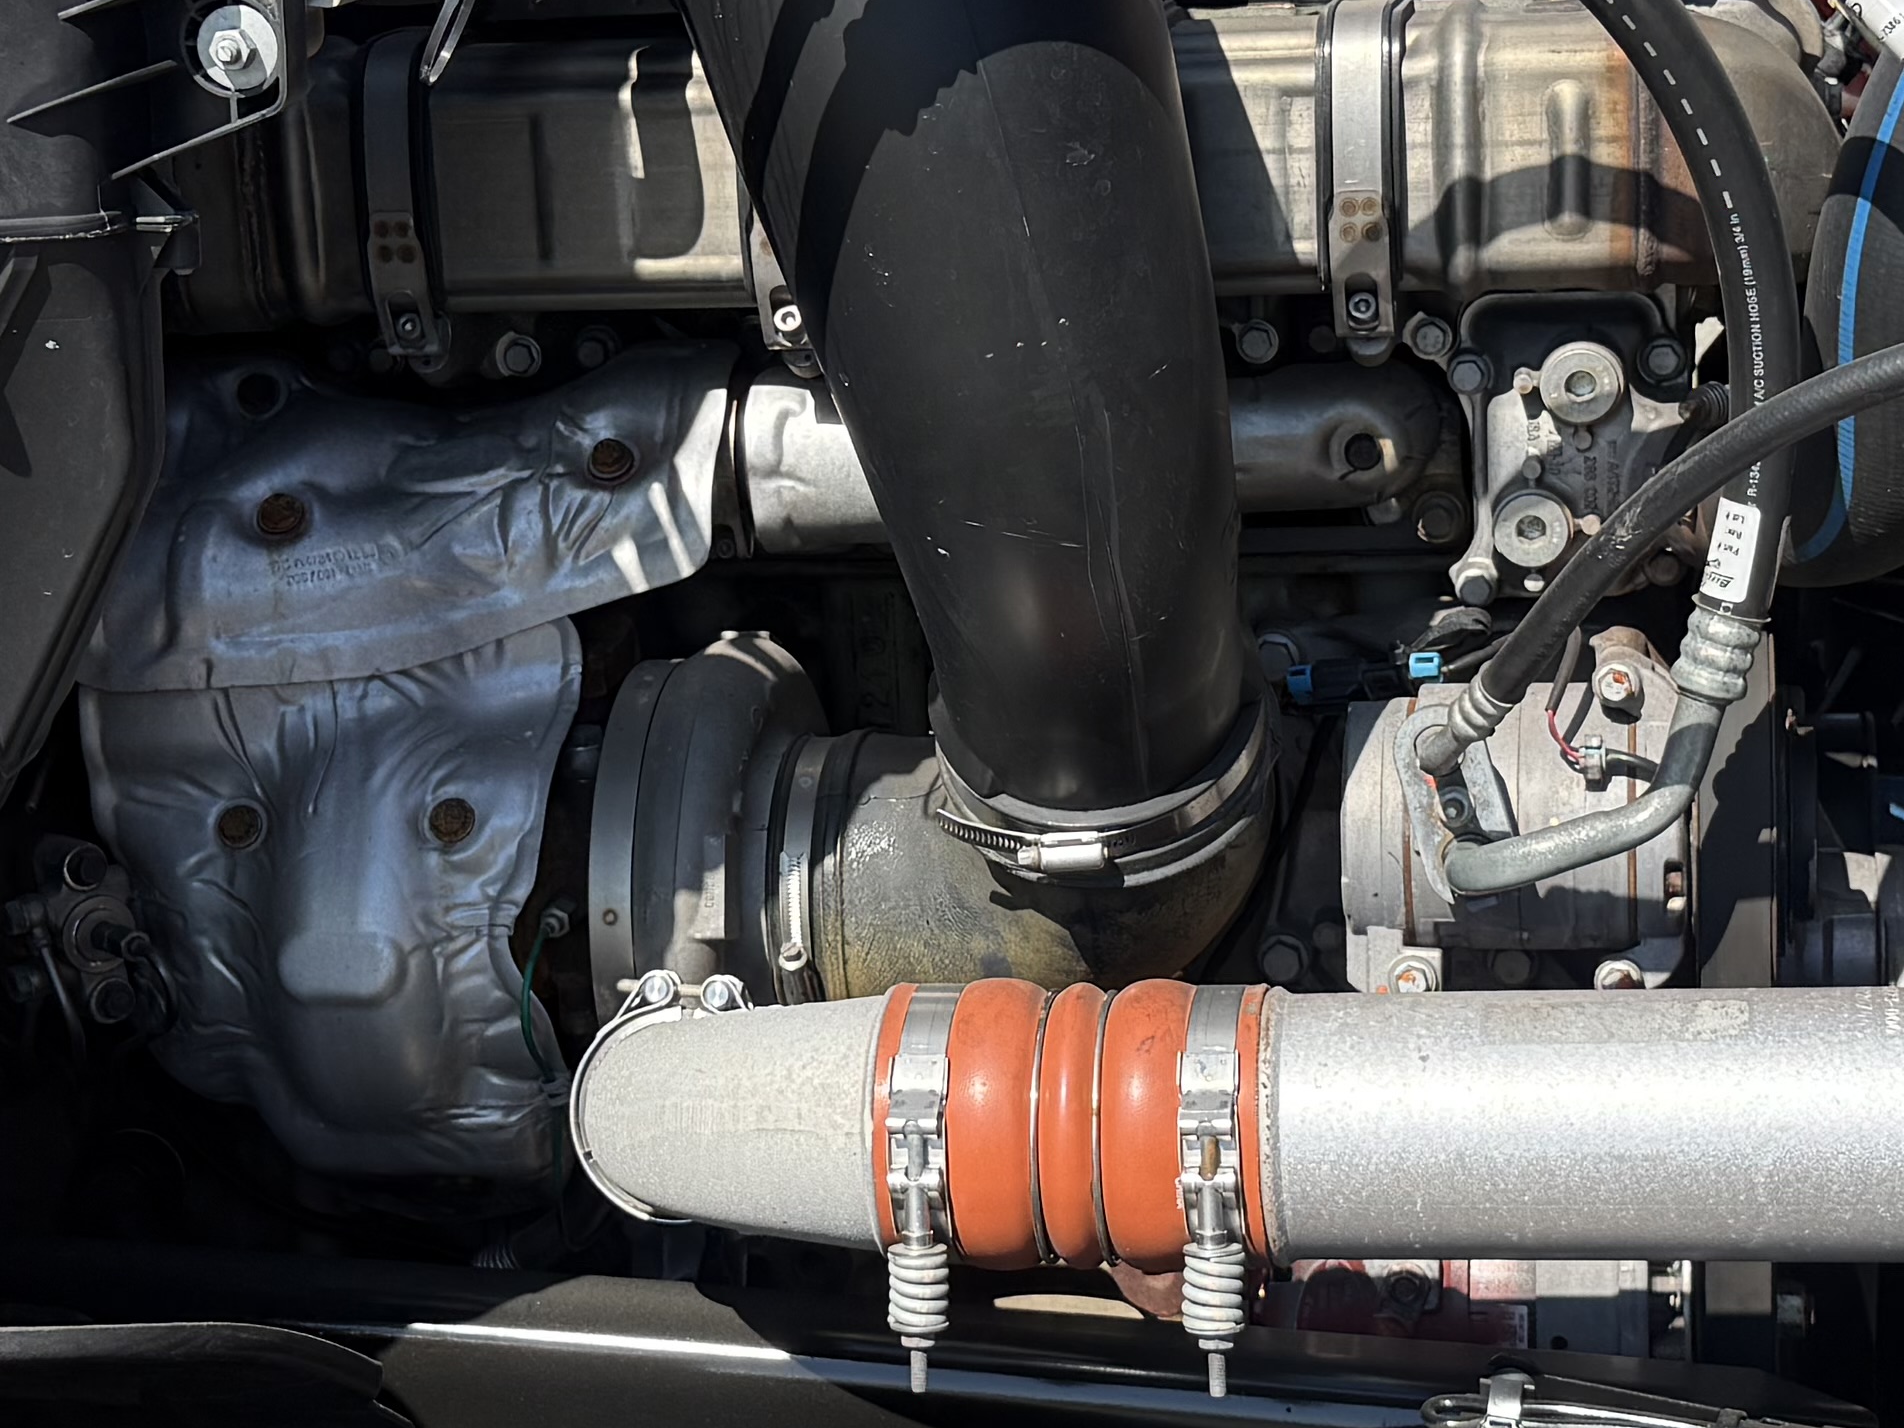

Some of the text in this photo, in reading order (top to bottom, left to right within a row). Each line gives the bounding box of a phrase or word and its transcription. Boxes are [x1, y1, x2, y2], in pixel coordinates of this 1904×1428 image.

[1733, 225, 1746, 244] 3/4
[1737, 244, 1757, 286] (19mm)
[1745, 286, 1760, 321] HOSE
[1749, 321, 1765, 378] SUCTION
[1754, 378, 1765, 401] A/C
